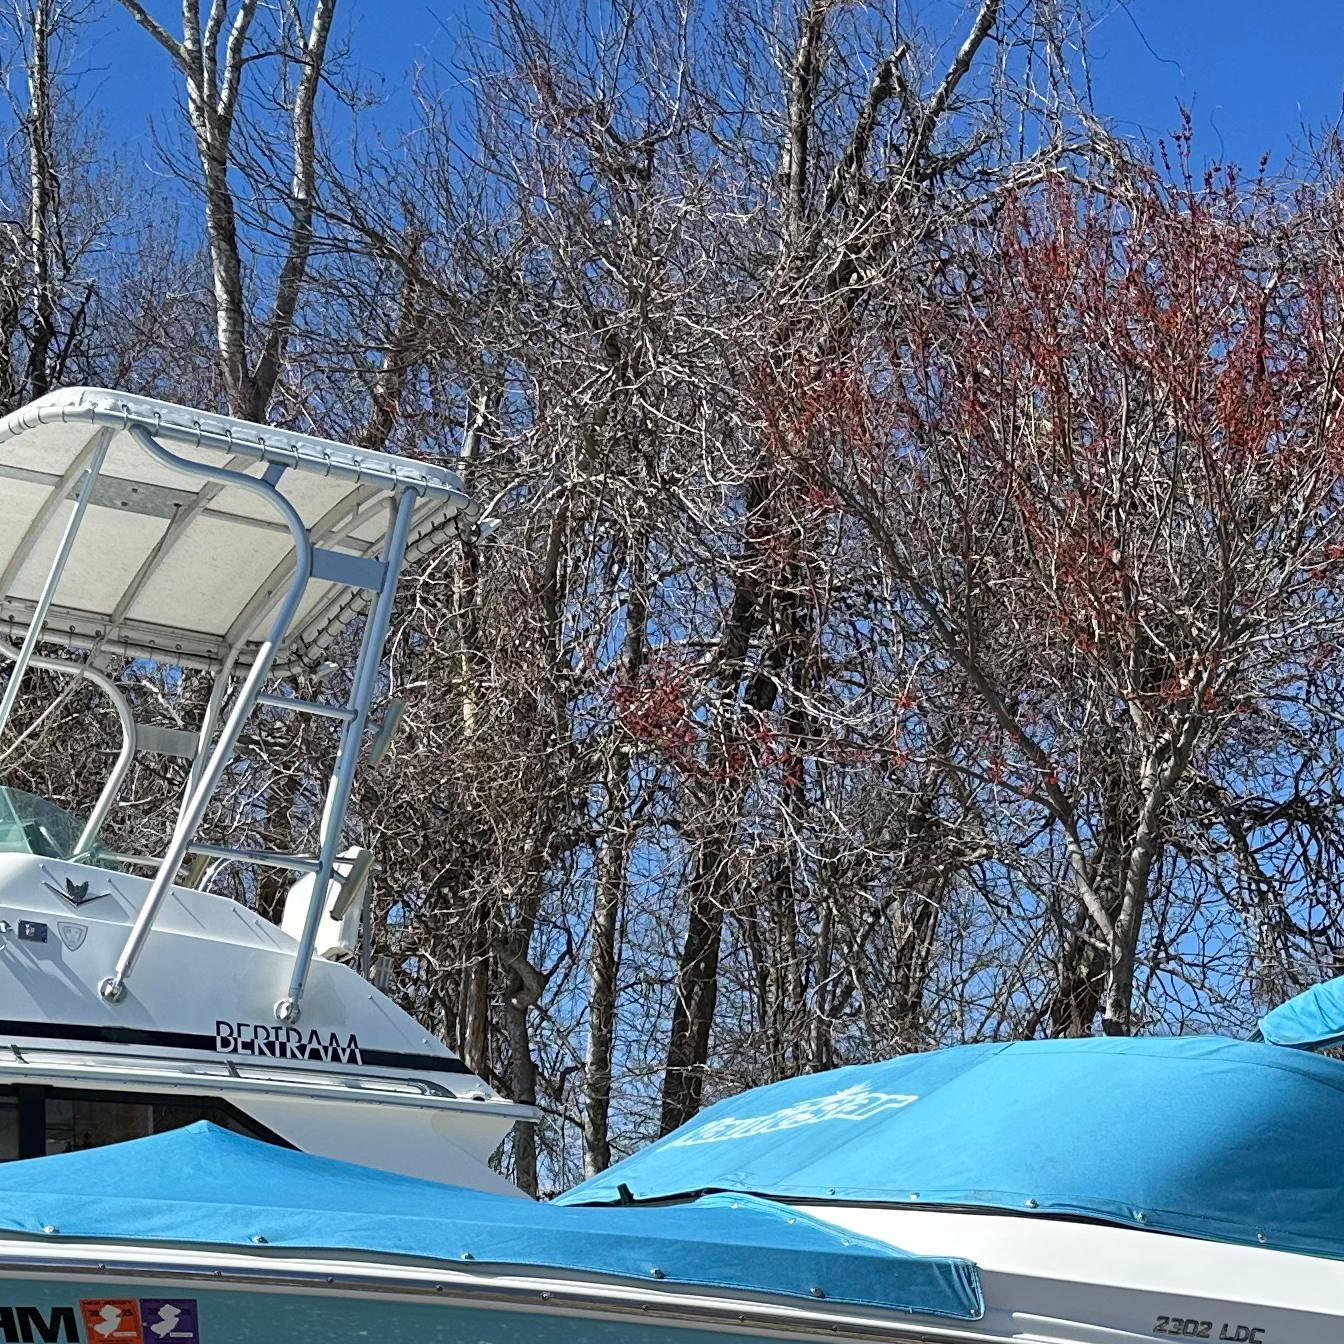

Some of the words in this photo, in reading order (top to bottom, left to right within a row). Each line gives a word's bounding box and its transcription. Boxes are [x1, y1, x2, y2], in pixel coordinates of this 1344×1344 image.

[215, 1019, 362, 1065] BERTRAM
[1153, 1315, 1213, 1339] 2302
[1219, 1323, 1265, 1344] LDC
